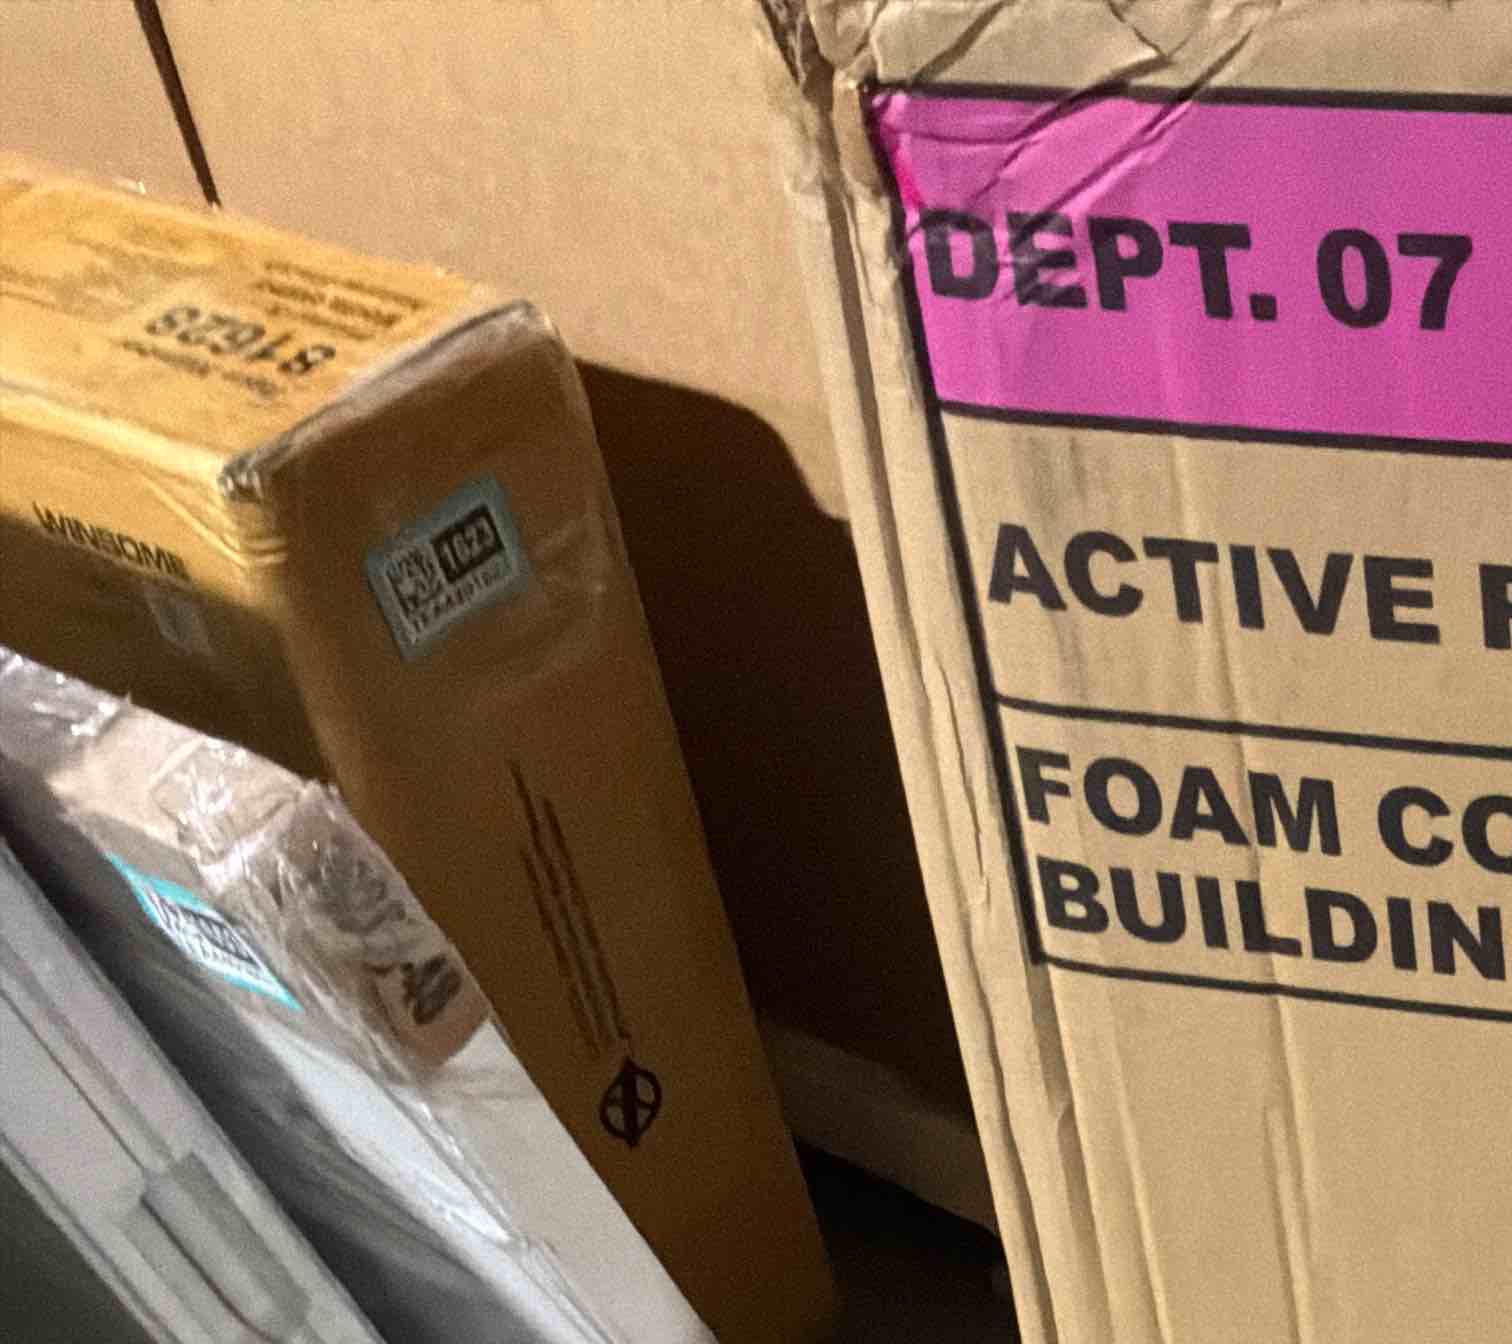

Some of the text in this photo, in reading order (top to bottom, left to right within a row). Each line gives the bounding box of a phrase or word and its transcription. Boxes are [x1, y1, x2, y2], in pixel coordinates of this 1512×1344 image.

[918, 208, 1474, 331] DEPT. 07
[989, 522, 1440, 646] ACTIVE
[1016, 744, 1342, 856] FOAM
